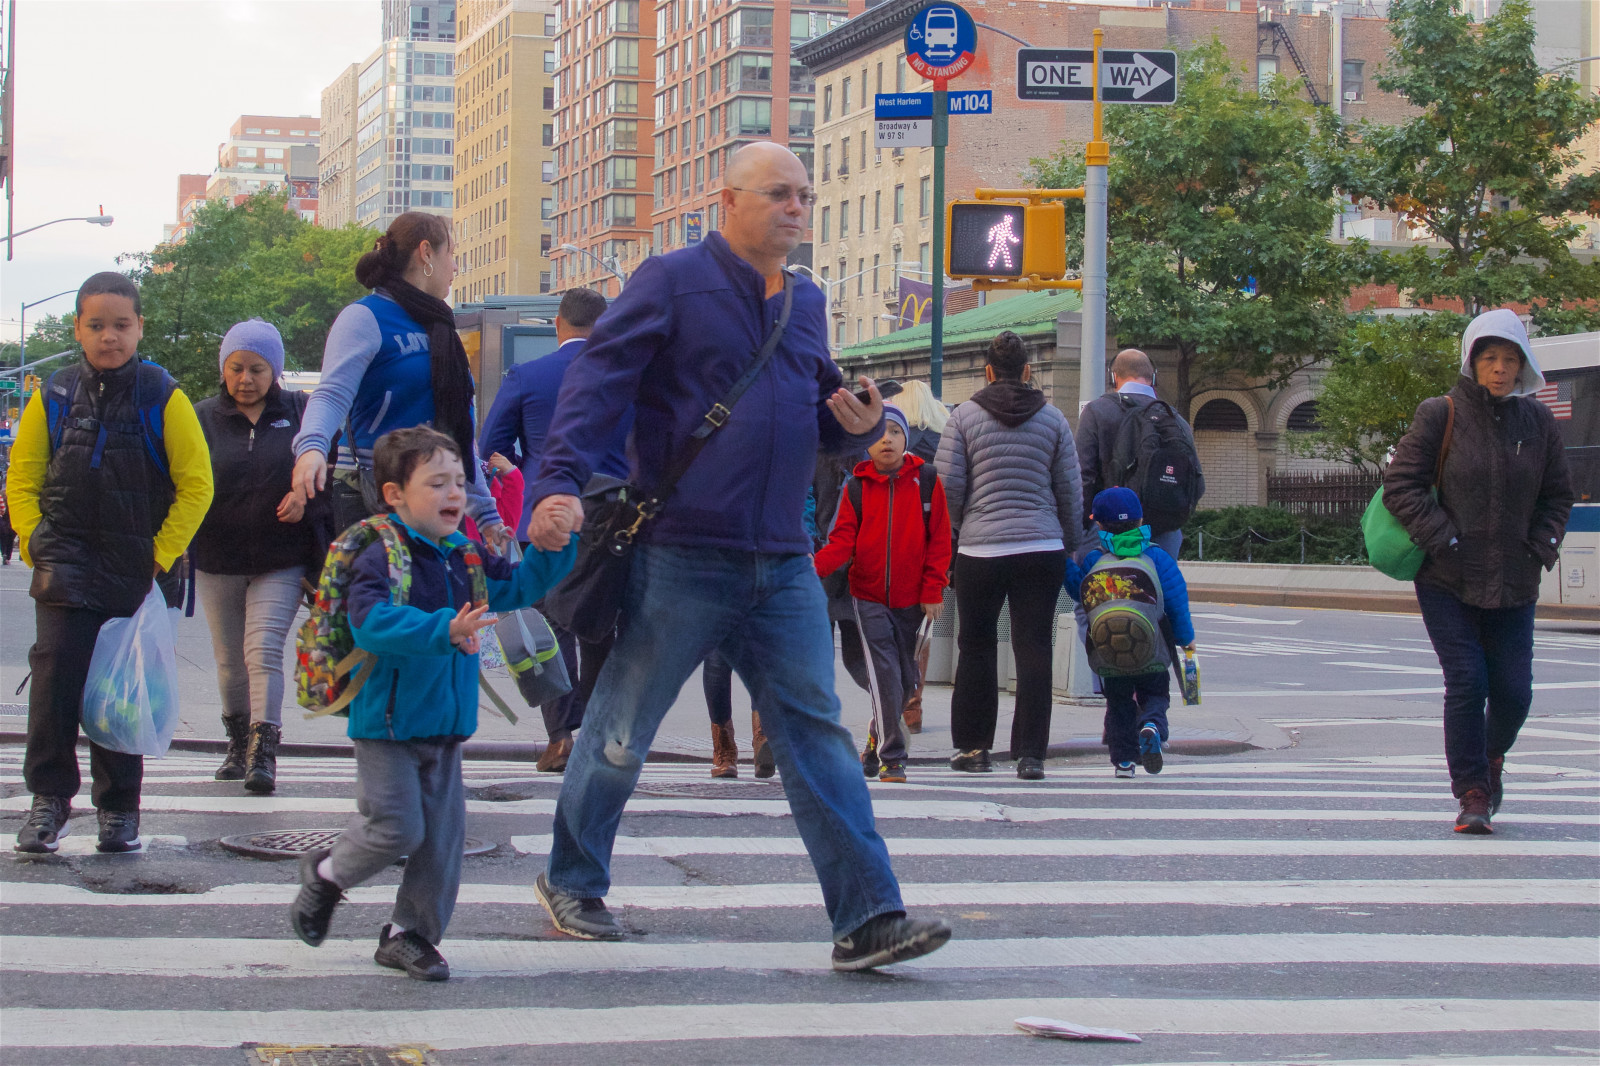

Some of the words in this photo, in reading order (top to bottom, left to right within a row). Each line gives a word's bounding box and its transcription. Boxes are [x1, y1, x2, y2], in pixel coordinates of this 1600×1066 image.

[912, 58, 925, 71] NO
[926, 57, 969, 77] STANDING
[1031, 65, 1082, 85] ONE
[1110, 66, 1158, 87] WAY
[878, 98, 896, 106] West
[897, 98, 922, 106] Harlem
[950, 94, 989, 111] M104
[878, 122, 911, 131] Broadway
[912, 122, 918, 130] &
[878, 132, 885, 140] W
[887, 132, 896, 140] 97
[393, 332, 430, 355] LOV
